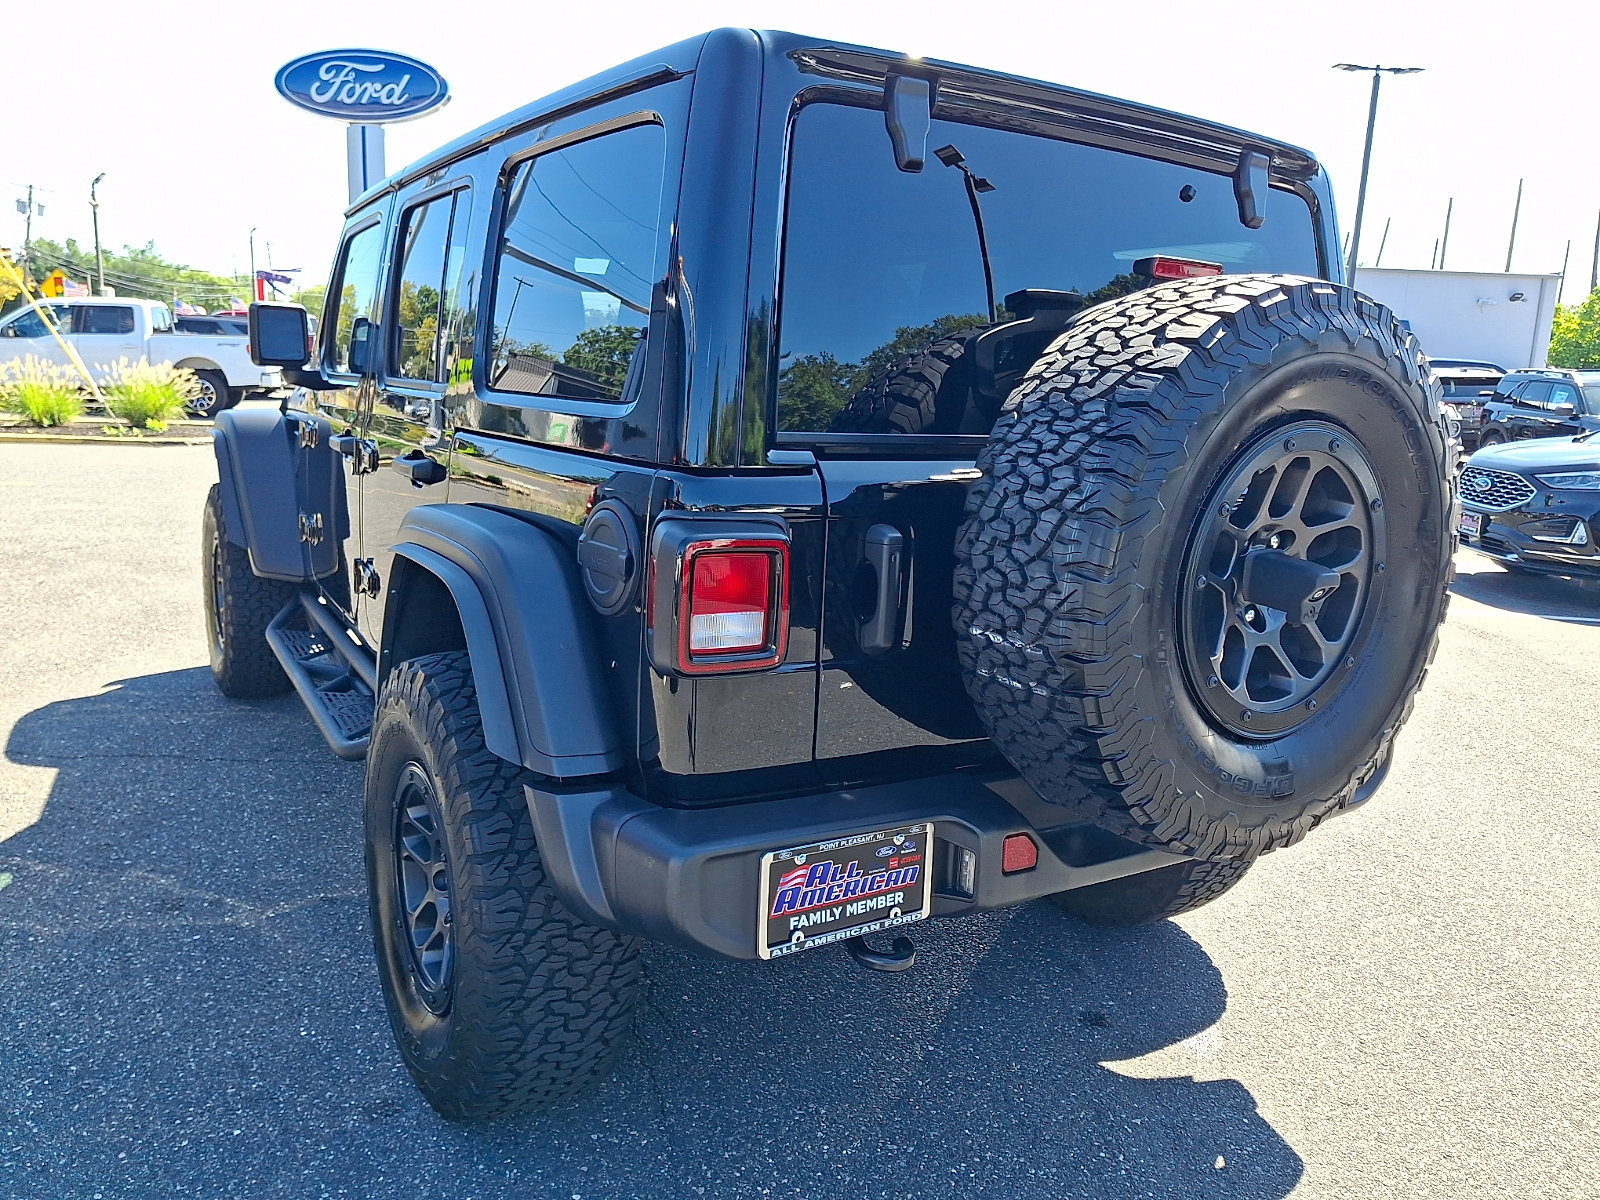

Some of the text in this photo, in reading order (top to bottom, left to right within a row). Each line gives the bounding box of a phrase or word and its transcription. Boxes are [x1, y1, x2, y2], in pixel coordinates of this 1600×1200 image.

[310, 61, 411, 105] Ford
[820, 841, 839, 851] POINT
[789, 891, 904, 931] FAMILY MEMBER
[772, 913, 922, 957] ALL AMERICAN FORD
